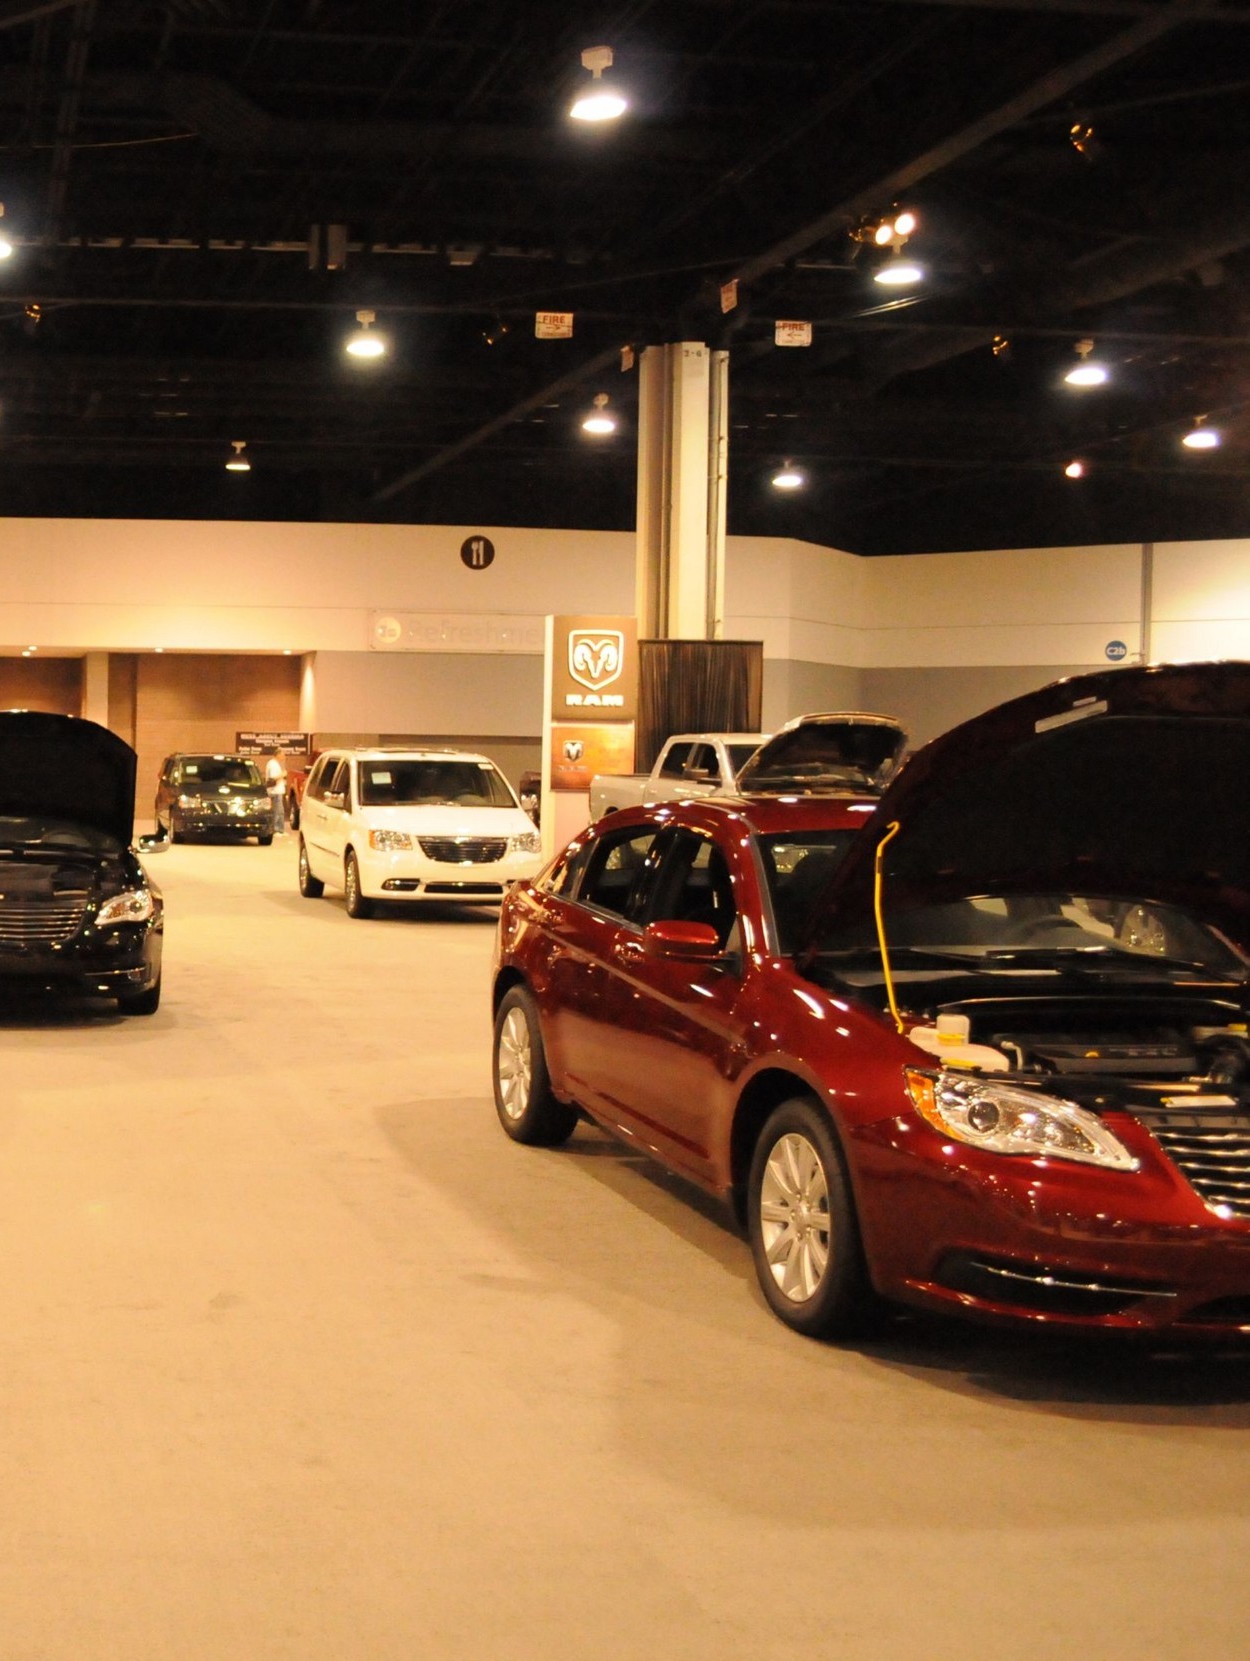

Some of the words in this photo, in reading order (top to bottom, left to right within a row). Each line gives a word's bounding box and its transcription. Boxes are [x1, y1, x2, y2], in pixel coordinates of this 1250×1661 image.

[542, 315, 565, 324] FIRE
[782, 322, 805, 331] FIRE
[565, 694, 624, 706] RAM
